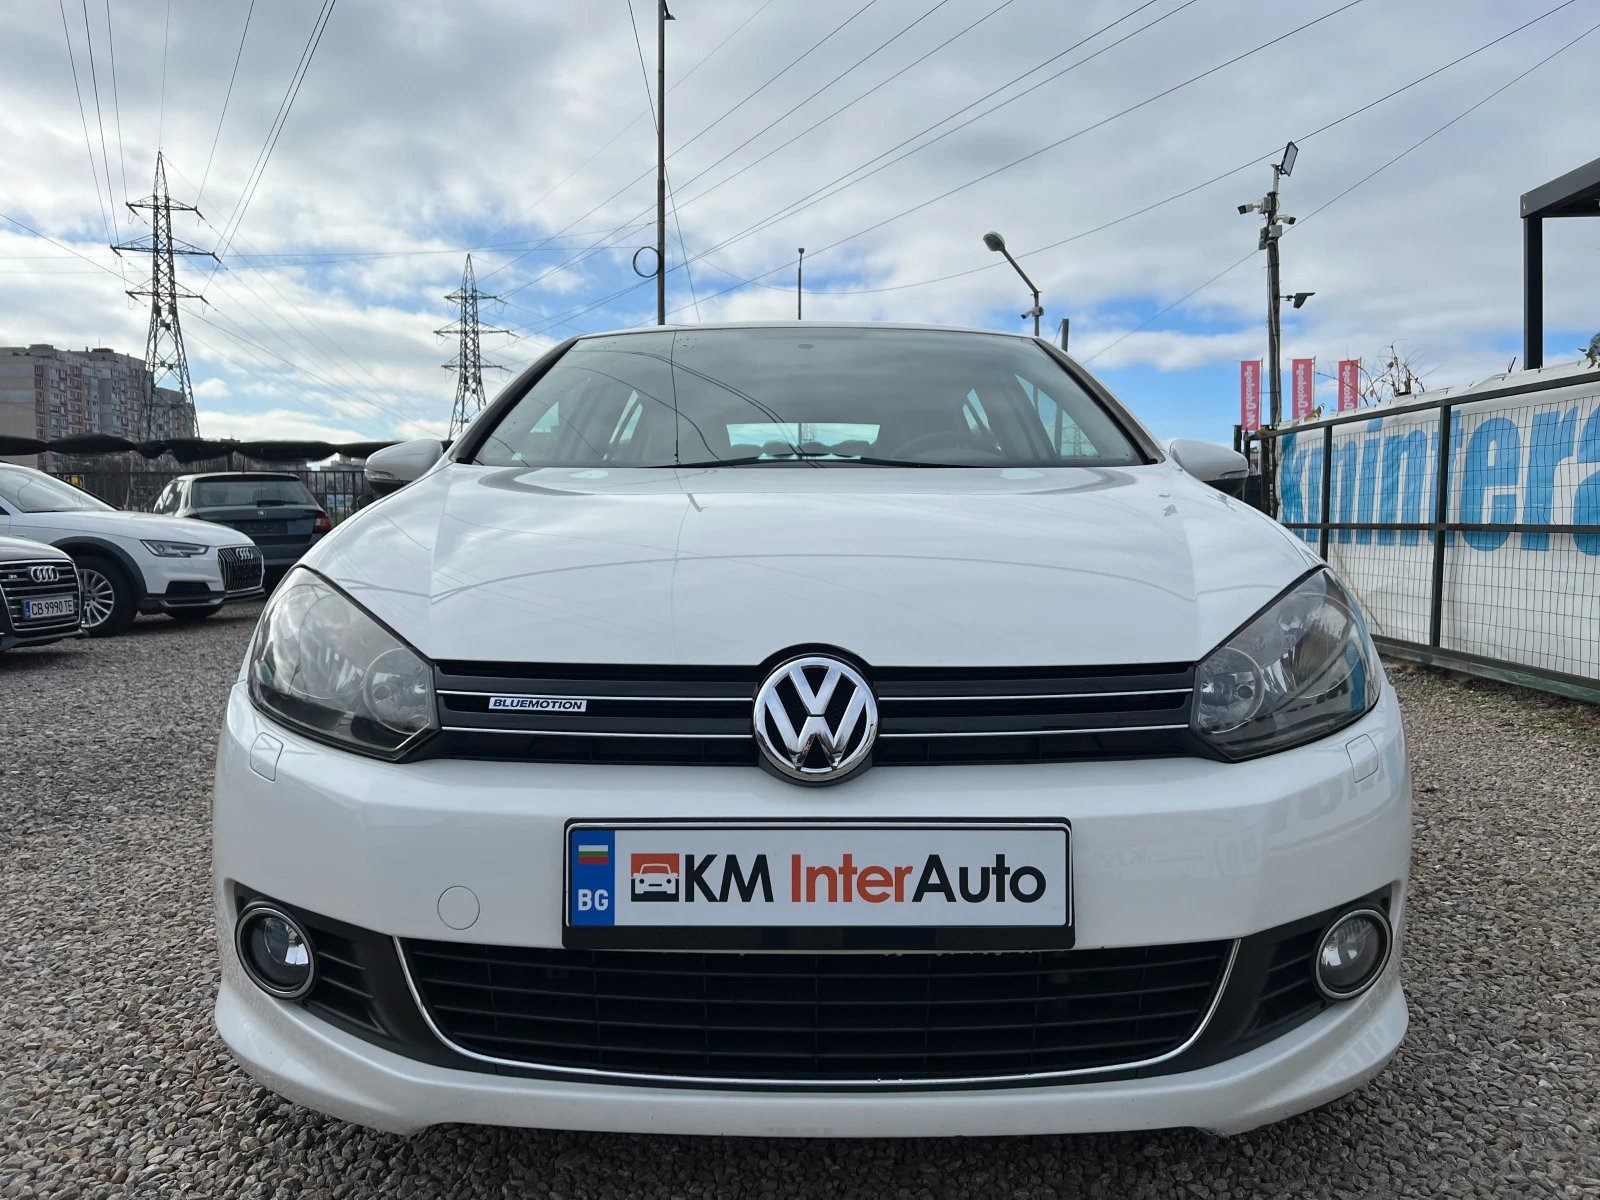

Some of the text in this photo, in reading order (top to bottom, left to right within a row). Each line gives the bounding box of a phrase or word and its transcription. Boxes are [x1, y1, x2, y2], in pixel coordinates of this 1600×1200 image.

[31, 600, 73, 616] CB 9990 TE
[492, 698, 583, 710] BLUEMOTION
[685, 854, 773, 903] KM
[791, 854, 1047, 903] InterAuto
[577, 888, 609, 912] BG
